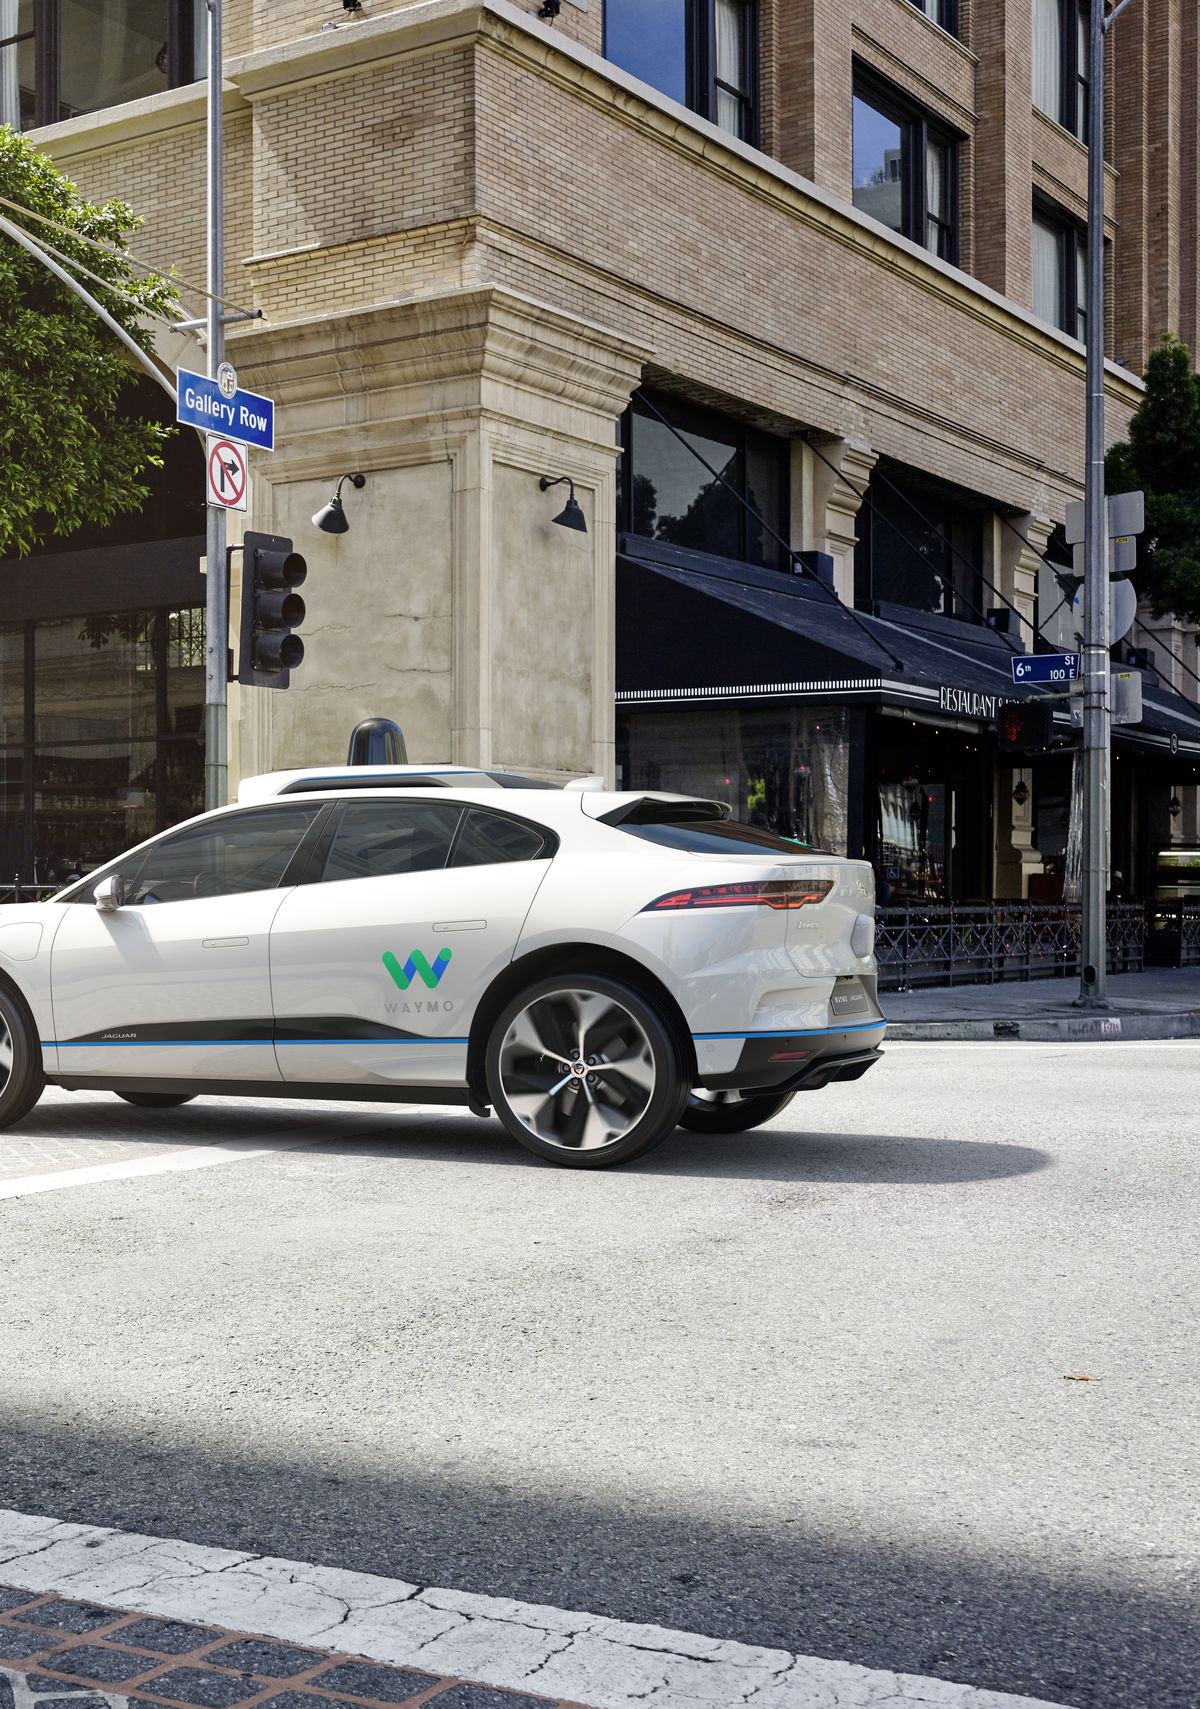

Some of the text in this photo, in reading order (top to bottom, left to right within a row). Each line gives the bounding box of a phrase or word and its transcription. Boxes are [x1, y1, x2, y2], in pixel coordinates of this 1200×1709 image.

[185, 387, 267, 432] Gallery Row
[1064, 655, 1075, 666] St
[1016, 662, 1032, 677] 6th
[1050, 668, 1075, 680] 100 E
[940, 686, 997, 718] RESTAURANT
[384, 1000, 454, 1014] WAYMO
